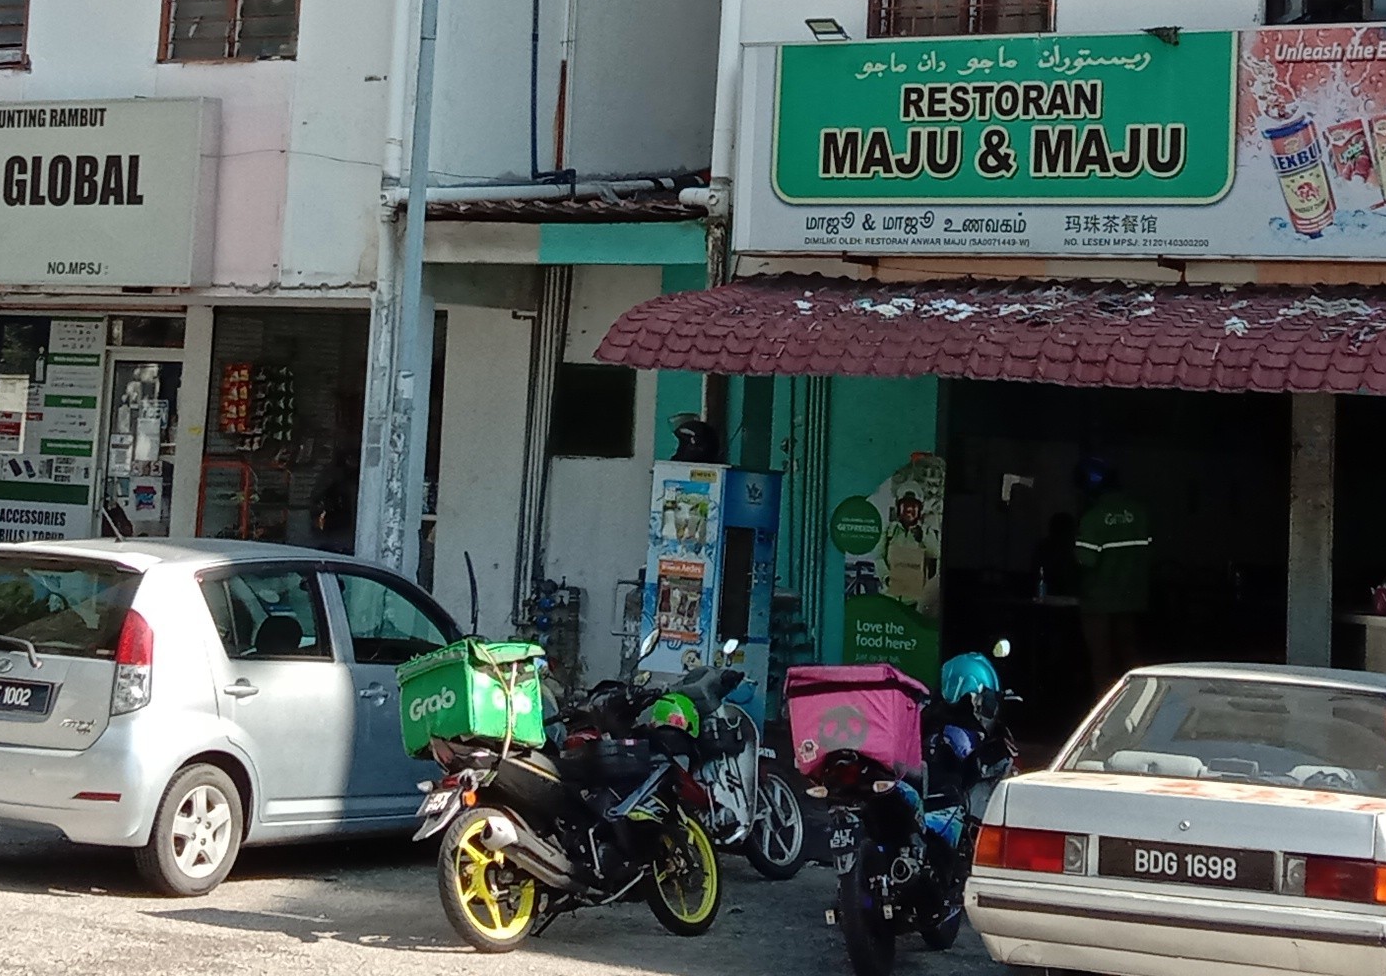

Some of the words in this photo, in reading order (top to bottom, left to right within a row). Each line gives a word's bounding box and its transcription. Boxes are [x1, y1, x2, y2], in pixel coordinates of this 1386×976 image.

[1274, 39, 1344, 62] Unleash
[1346, 39, 1376, 61] the
[902, 81, 1101, 120] RESTORAN
[49, 107, 108, 127] RAMBUT
[821, 126, 961, 178] MAJU
[976, 127, 1016, 177] &
[1032, 125, 1186, 177] MAJU
[2, 154, 144, 207] GLOBAL
[862, 213, 876, 231] &
[1064, 213, 1159, 235] 玛珠茶餐馆
[865, 237, 909, 246] RESTORAN
[910, 237, 941, 246] ANWAR
[943, 237, 967, 247] MAJU
[1082, 238, 1111, 246] LESEN
[47, 261, 101, 275] NO.MPSJ
[0, 508, 67, 527] ACCESSORIES
[856, 619, 883, 634] Love
[885, 621, 904, 635] the
[855, 633, 884, 648] food
[885, 635, 917, 651] here?
[3, 686, 32, 706] 1002
[409, 685, 457, 722] Grab
[1134, 849, 1178, 877] BDG
[1184, 851, 1238, 881] 1698
